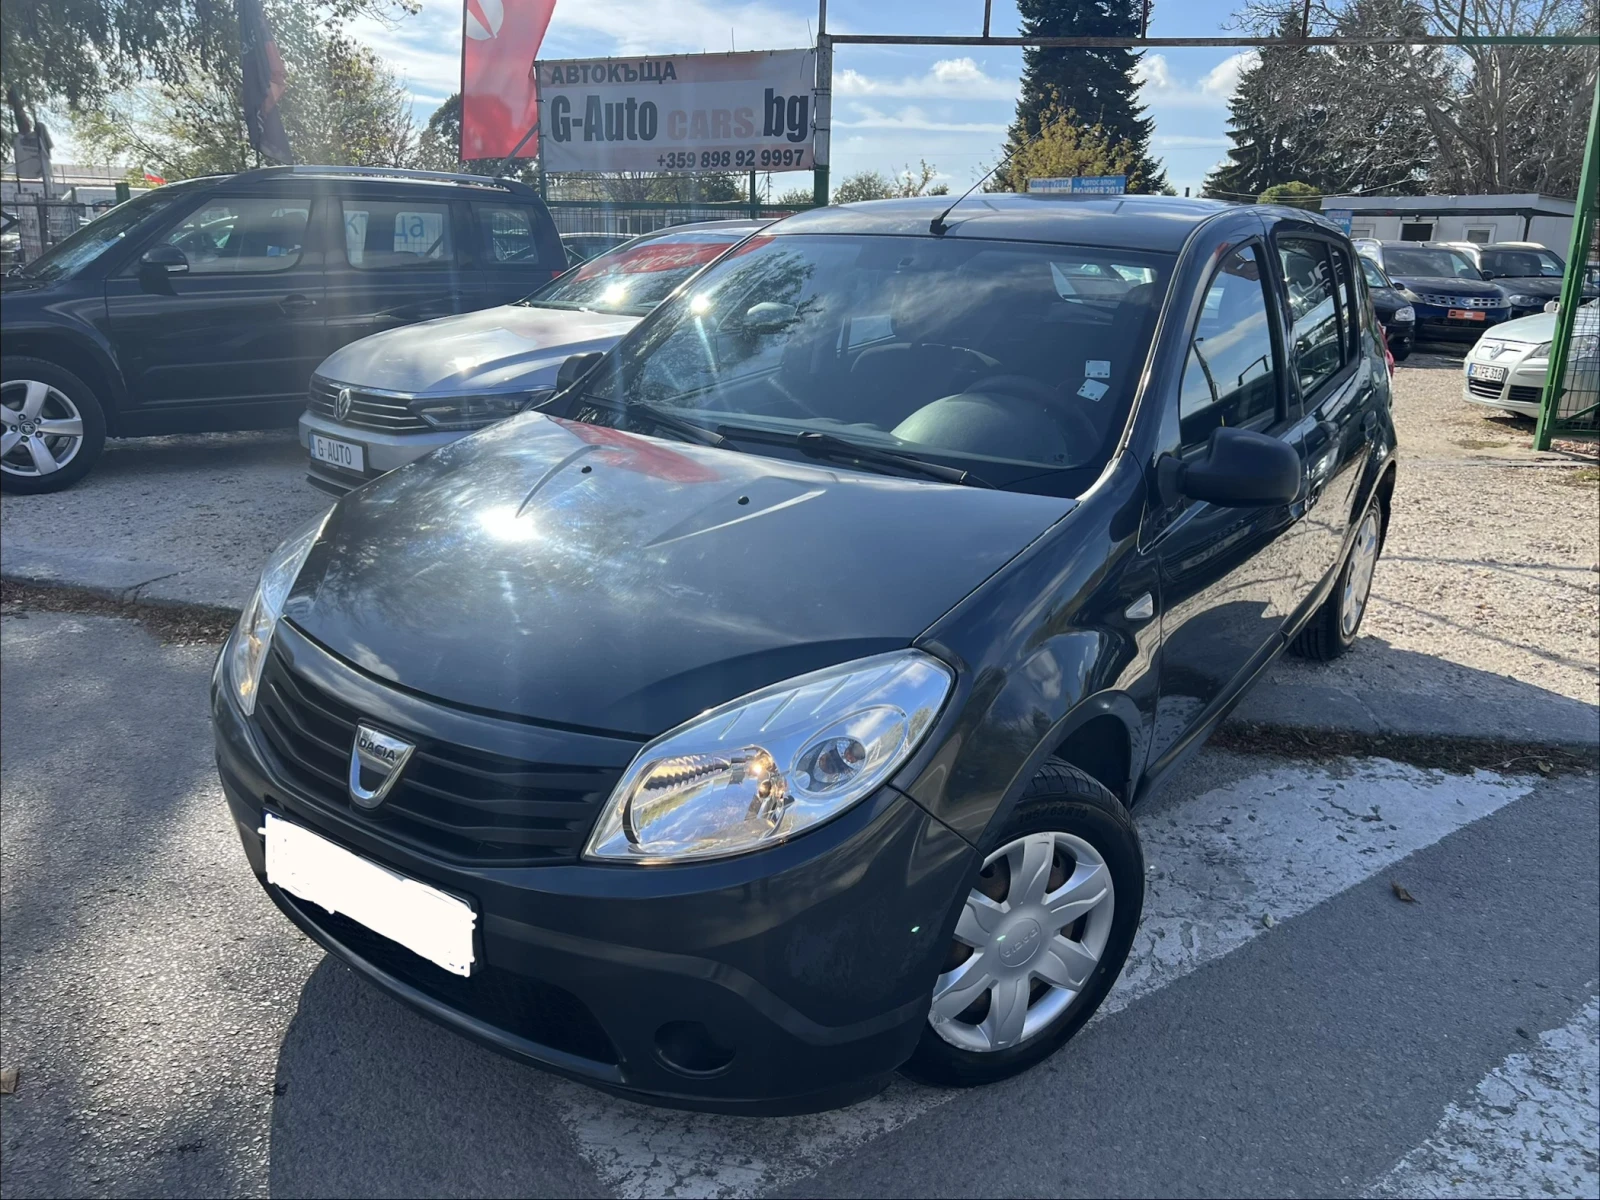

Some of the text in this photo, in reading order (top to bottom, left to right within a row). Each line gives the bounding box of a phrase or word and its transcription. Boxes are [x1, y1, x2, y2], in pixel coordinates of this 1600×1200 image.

[551, 61, 677, 84] АВТОКЪЩА
[551, 95, 658, 142] G-Auto
[657, 148, 804, 169] +359 898 92 9997
[359, 738, 396, 761] DACIA
